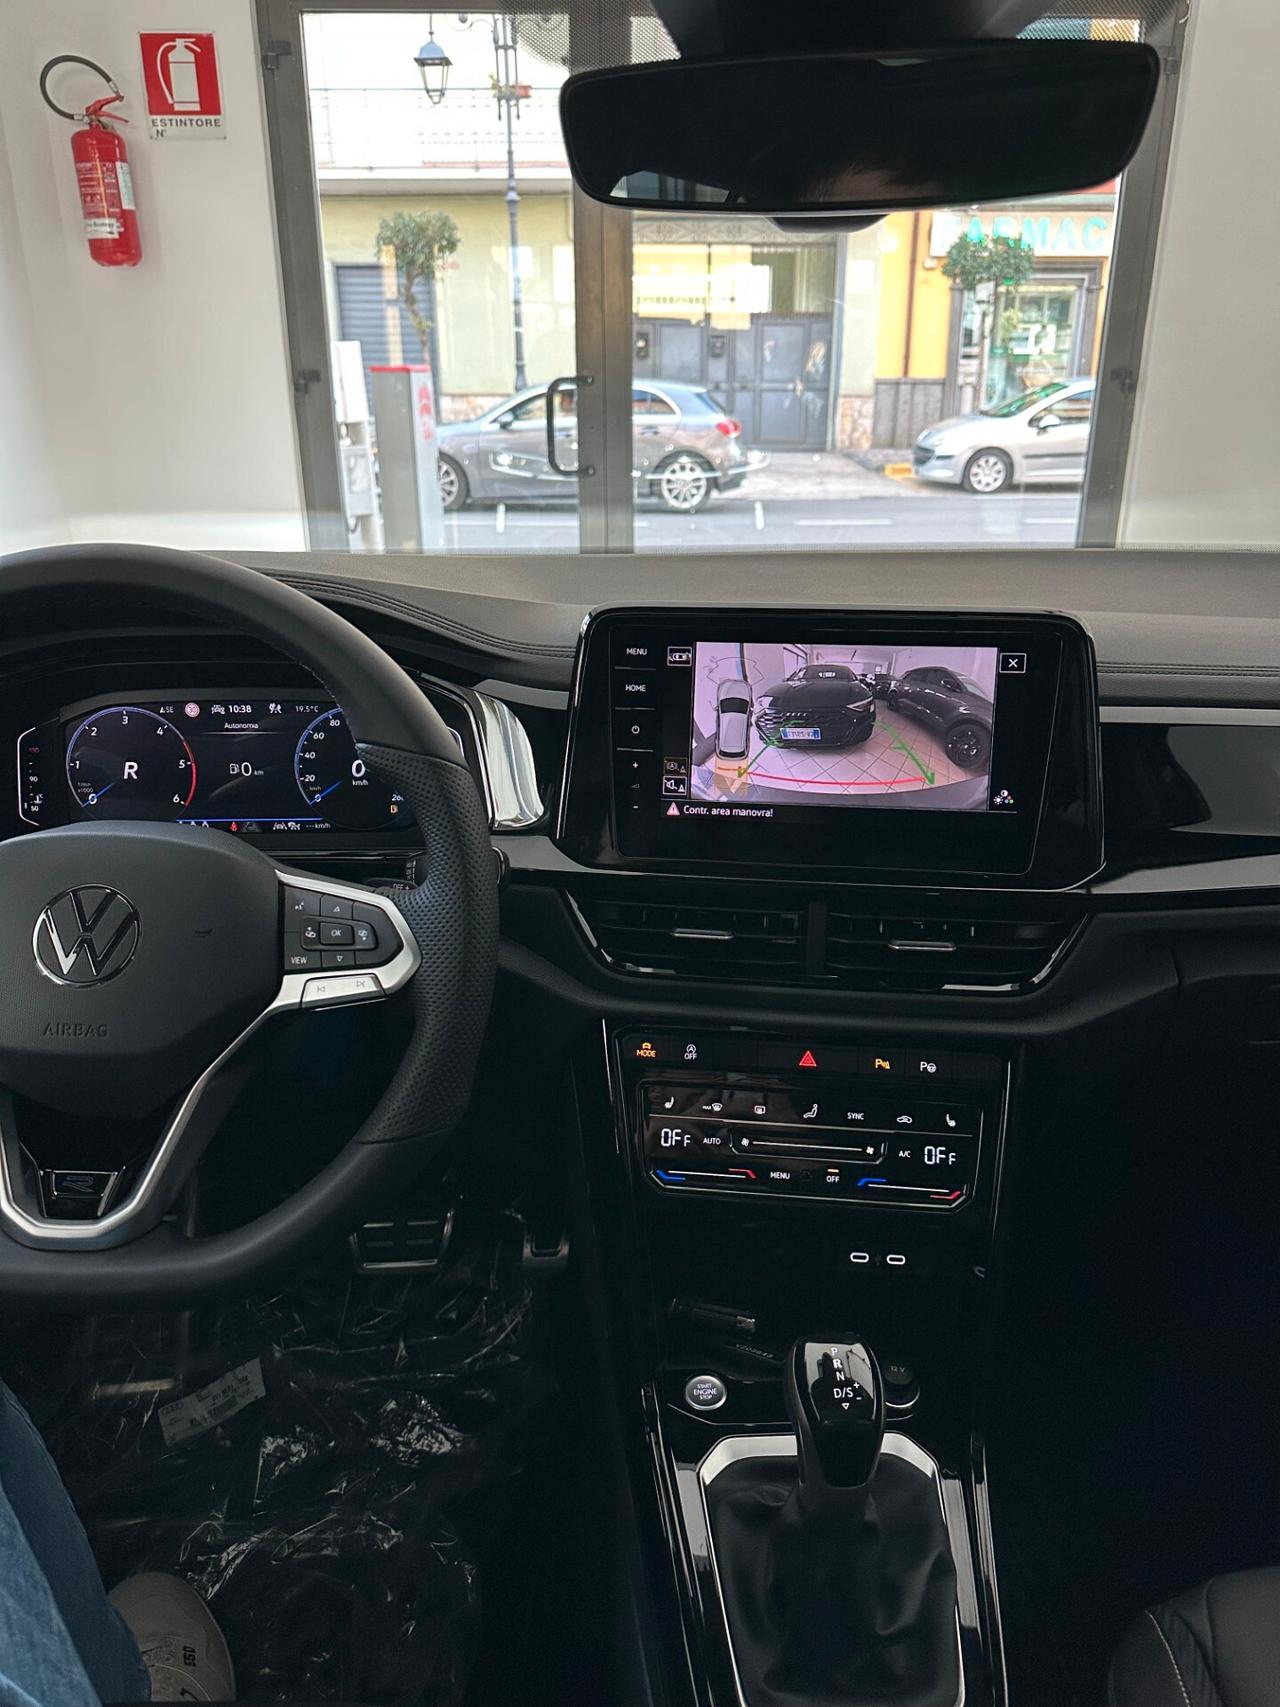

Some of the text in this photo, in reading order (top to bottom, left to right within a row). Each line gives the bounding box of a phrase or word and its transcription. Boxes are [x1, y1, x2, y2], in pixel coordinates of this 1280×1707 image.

[151, 118, 221, 128] ESTINTORE
[625, 684, 646, 692] HOME
[228, 705, 252, 713] 10:38
[295, 705, 319, 713] 19.5°C
[122, 716, 128, 725] 3
[91, 728, 98, 736] 2
[313, 732, 325, 740] 60
[178, 759, 186, 768] 5
[123, 761, 138, 780] R
[241, 762, 252, 776] 0
[351, 759, 365, 777] 0
[304, 774, 316, 782] 20
[173, 794, 180, 803] 6
[683, 804, 774, 817] Contr. area manovra!
[331, 929, 342, 937] OK
[291, 956, 307, 964] VIEW
[42, 1023, 109, 1037] AIRBAG
[636, 1050, 656, 1058] MODE
[847, 1112, 864, 1120] SYNC
[703, 1137, 721, 1145] AUTO
[898, 1150, 911, 1158] A/C
[770, 1172, 790, 1180] MENU
[831, 1347, 838, 1356] P
[833, 1359, 842, 1369] R
[836, 1371, 845, 1381] N
[833, 1387, 854, 1399] D/S
